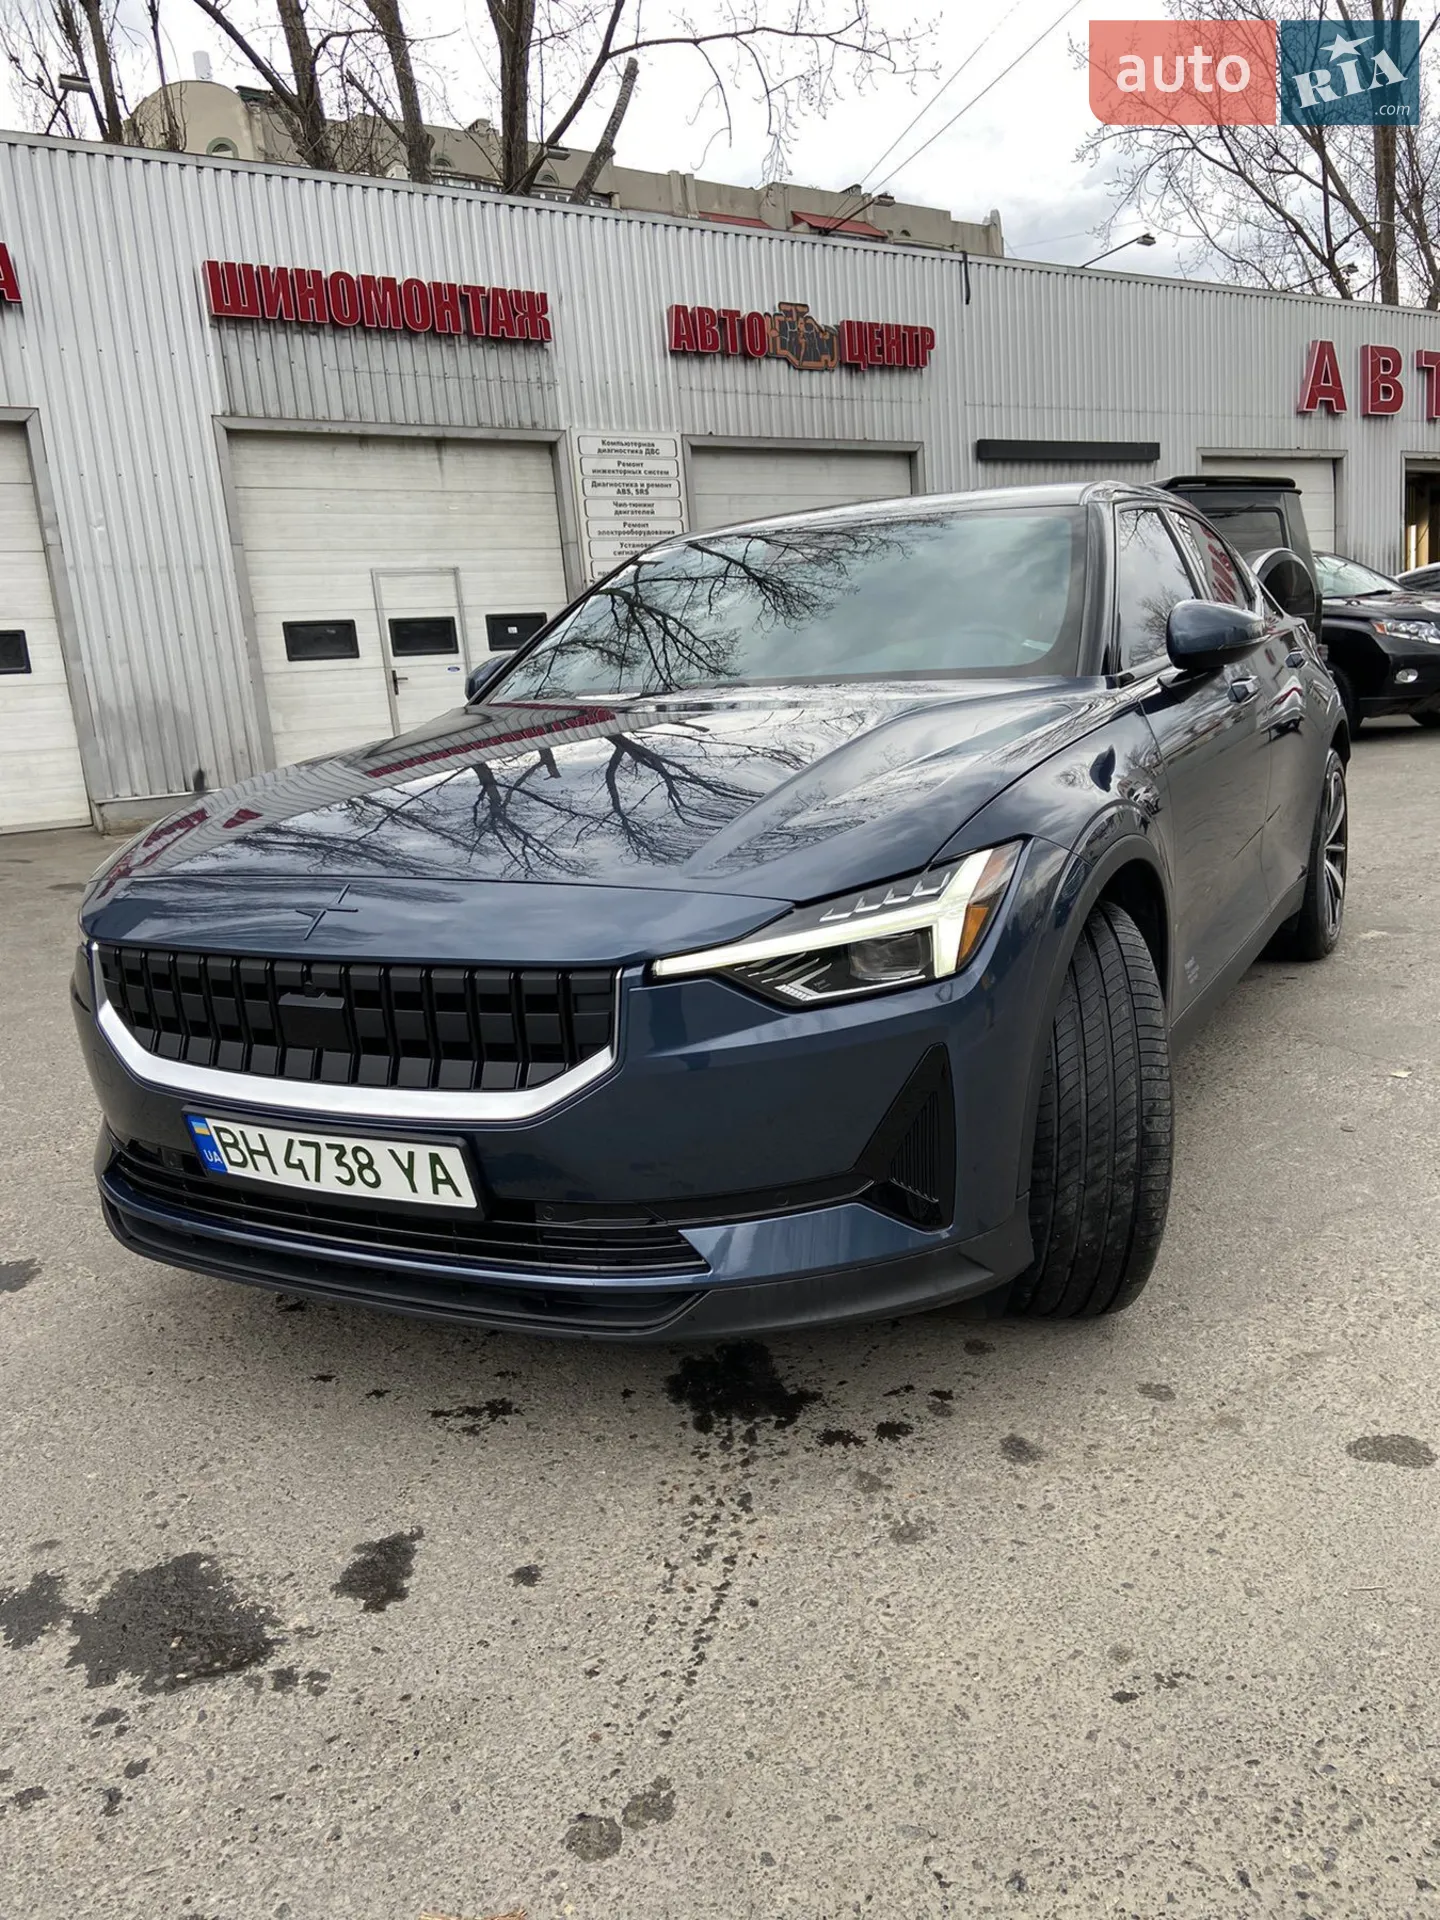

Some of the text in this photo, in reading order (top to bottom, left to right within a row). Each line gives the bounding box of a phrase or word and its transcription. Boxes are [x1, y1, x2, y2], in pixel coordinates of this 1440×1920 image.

[202, 260, 552, 342] ШИНОМОНТАЖ
[667, 304, 936, 370] АВТО ЦЕНТР
[601, 440, 655, 448] Компьютерная
[613, 508, 655, 516] двигателей
[203, 1148, 223, 1164] UA
[212, 1125, 463, 1198] BH 4738 YA
